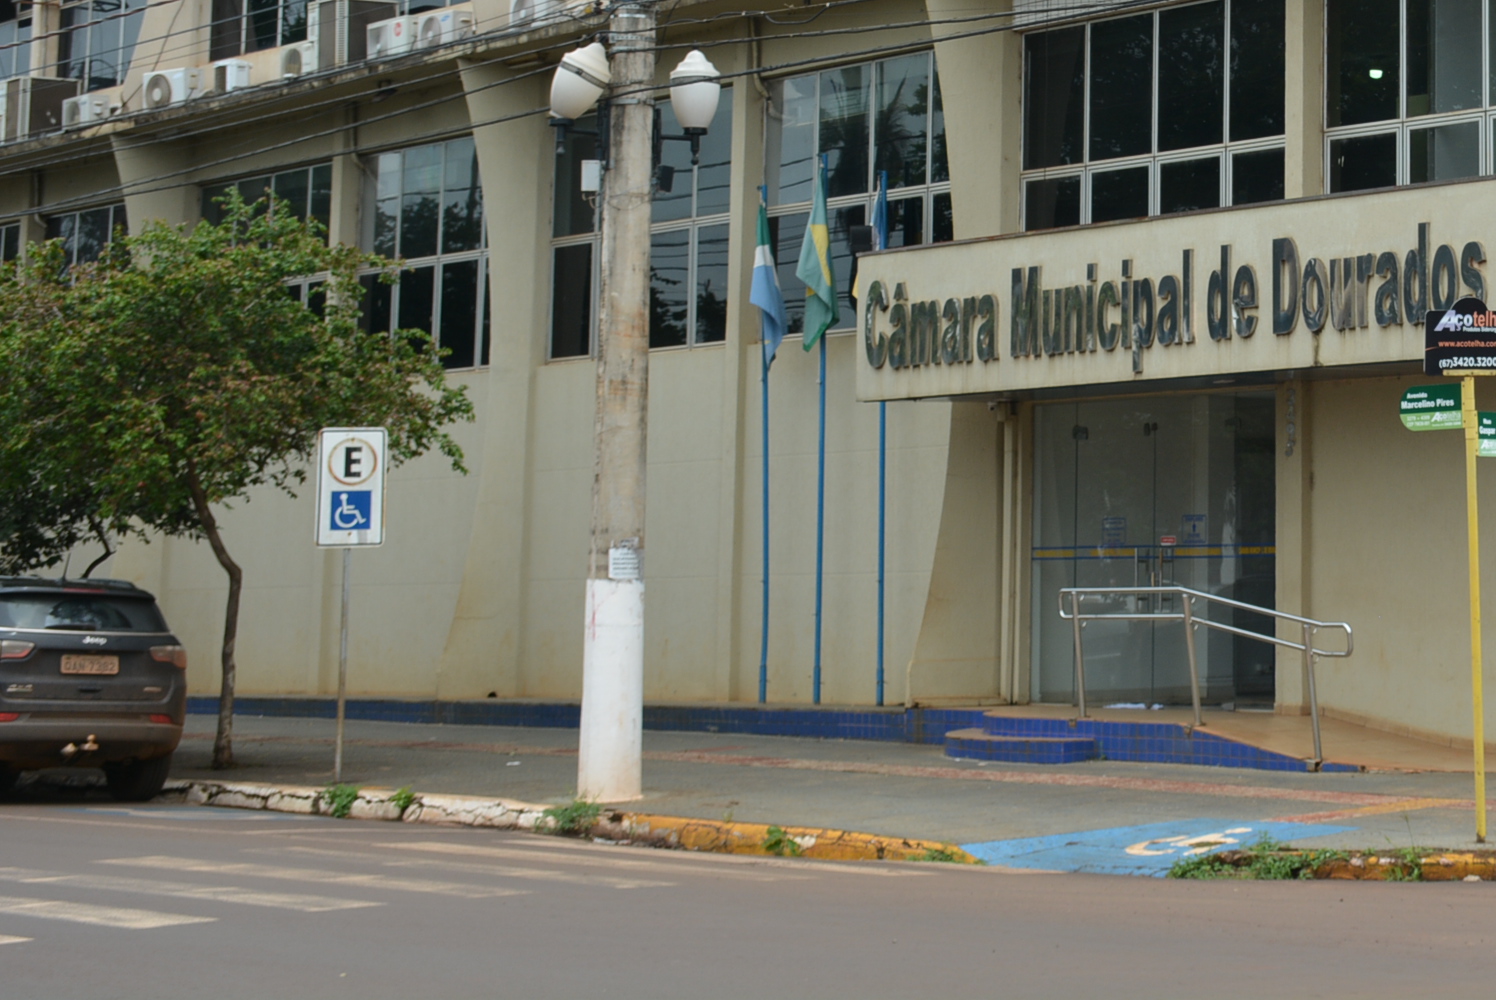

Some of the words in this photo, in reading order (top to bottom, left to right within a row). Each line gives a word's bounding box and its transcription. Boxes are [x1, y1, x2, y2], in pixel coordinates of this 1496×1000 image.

[865, 279, 999, 369] Câmara
[1010, 248, 1195, 374] Municipal
[1206, 244, 1259, 342] de
[1272, 222, 1488, 336] Dourados
[1401, 399, 1435, 409] Marcelino
[1436, 398, 1455, 407] Pires
[344, 446, 362, 478] E
